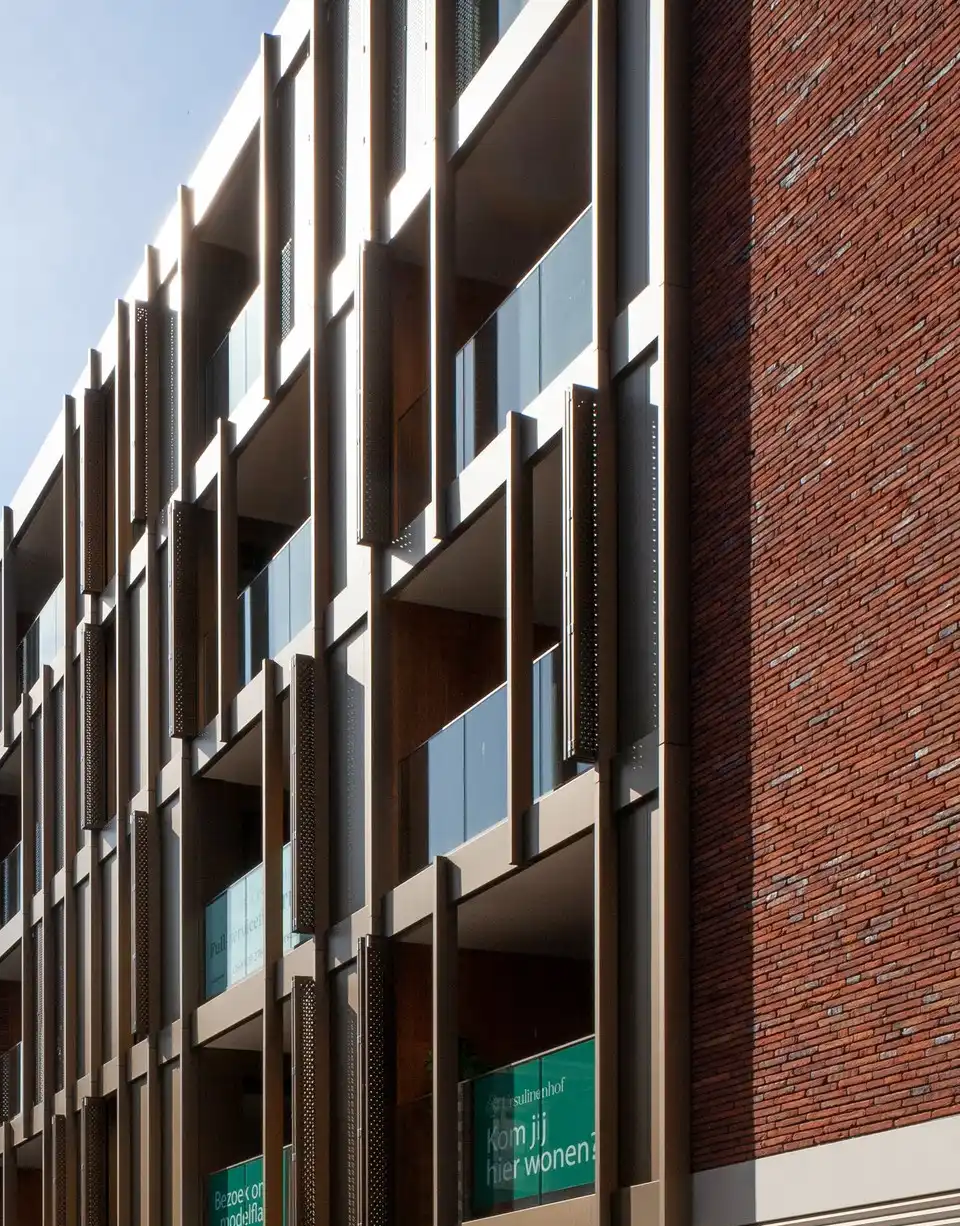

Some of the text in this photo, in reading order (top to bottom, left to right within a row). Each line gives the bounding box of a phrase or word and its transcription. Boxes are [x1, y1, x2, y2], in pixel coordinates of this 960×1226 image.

[487, 1111, 546, 1154] Kom jij
[486, 1157, 520, 1187] hier
